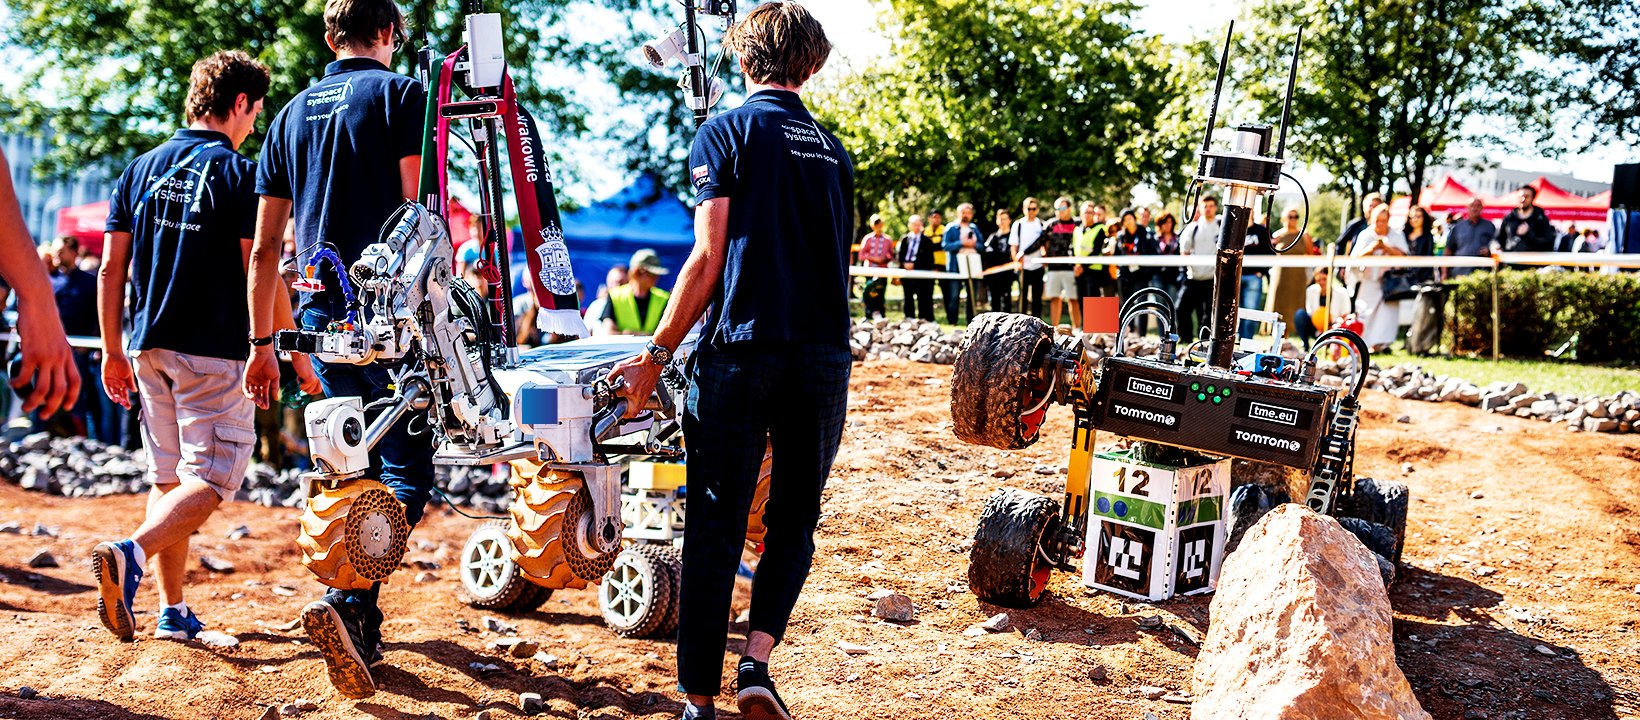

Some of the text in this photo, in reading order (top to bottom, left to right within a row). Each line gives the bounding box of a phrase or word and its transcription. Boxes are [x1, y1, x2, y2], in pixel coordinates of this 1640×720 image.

[784, 131, 821, 144] systems
[1132, 380, 1169, 397] tme.eu
[1254, 405, 1294, 422] tme.eu
[1112, 466, 1150, 497] 12
[1191, 468, 1212, 496] 12
